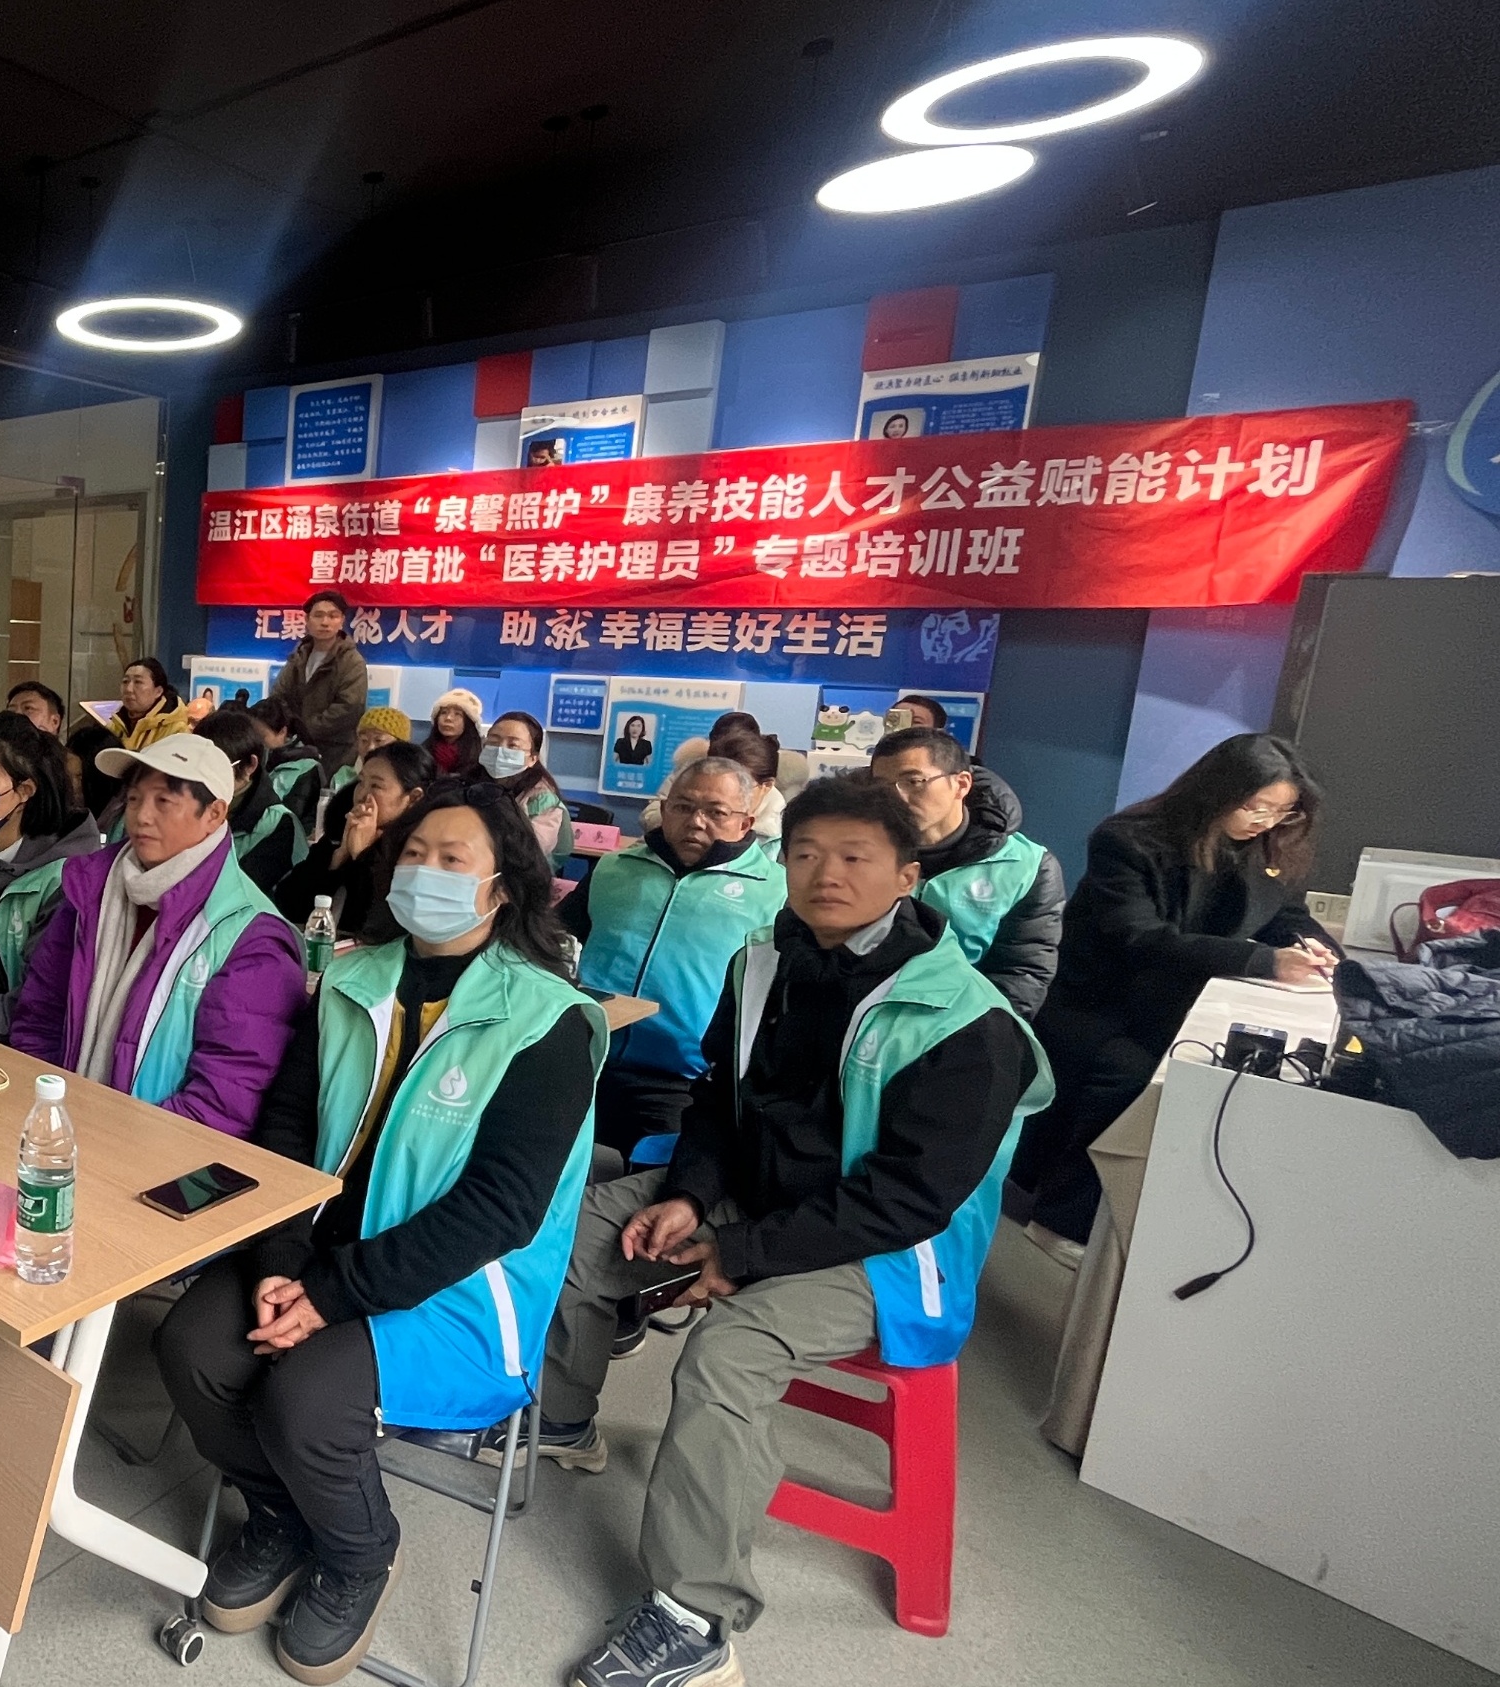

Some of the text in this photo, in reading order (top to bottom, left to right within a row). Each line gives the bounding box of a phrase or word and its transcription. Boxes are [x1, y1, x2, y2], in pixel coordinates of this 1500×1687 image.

[309, 526, 1024, 584] 暨成都首批“医养护理员”专题培训班
[254, 608, 454, 645] 汇聚能人才
